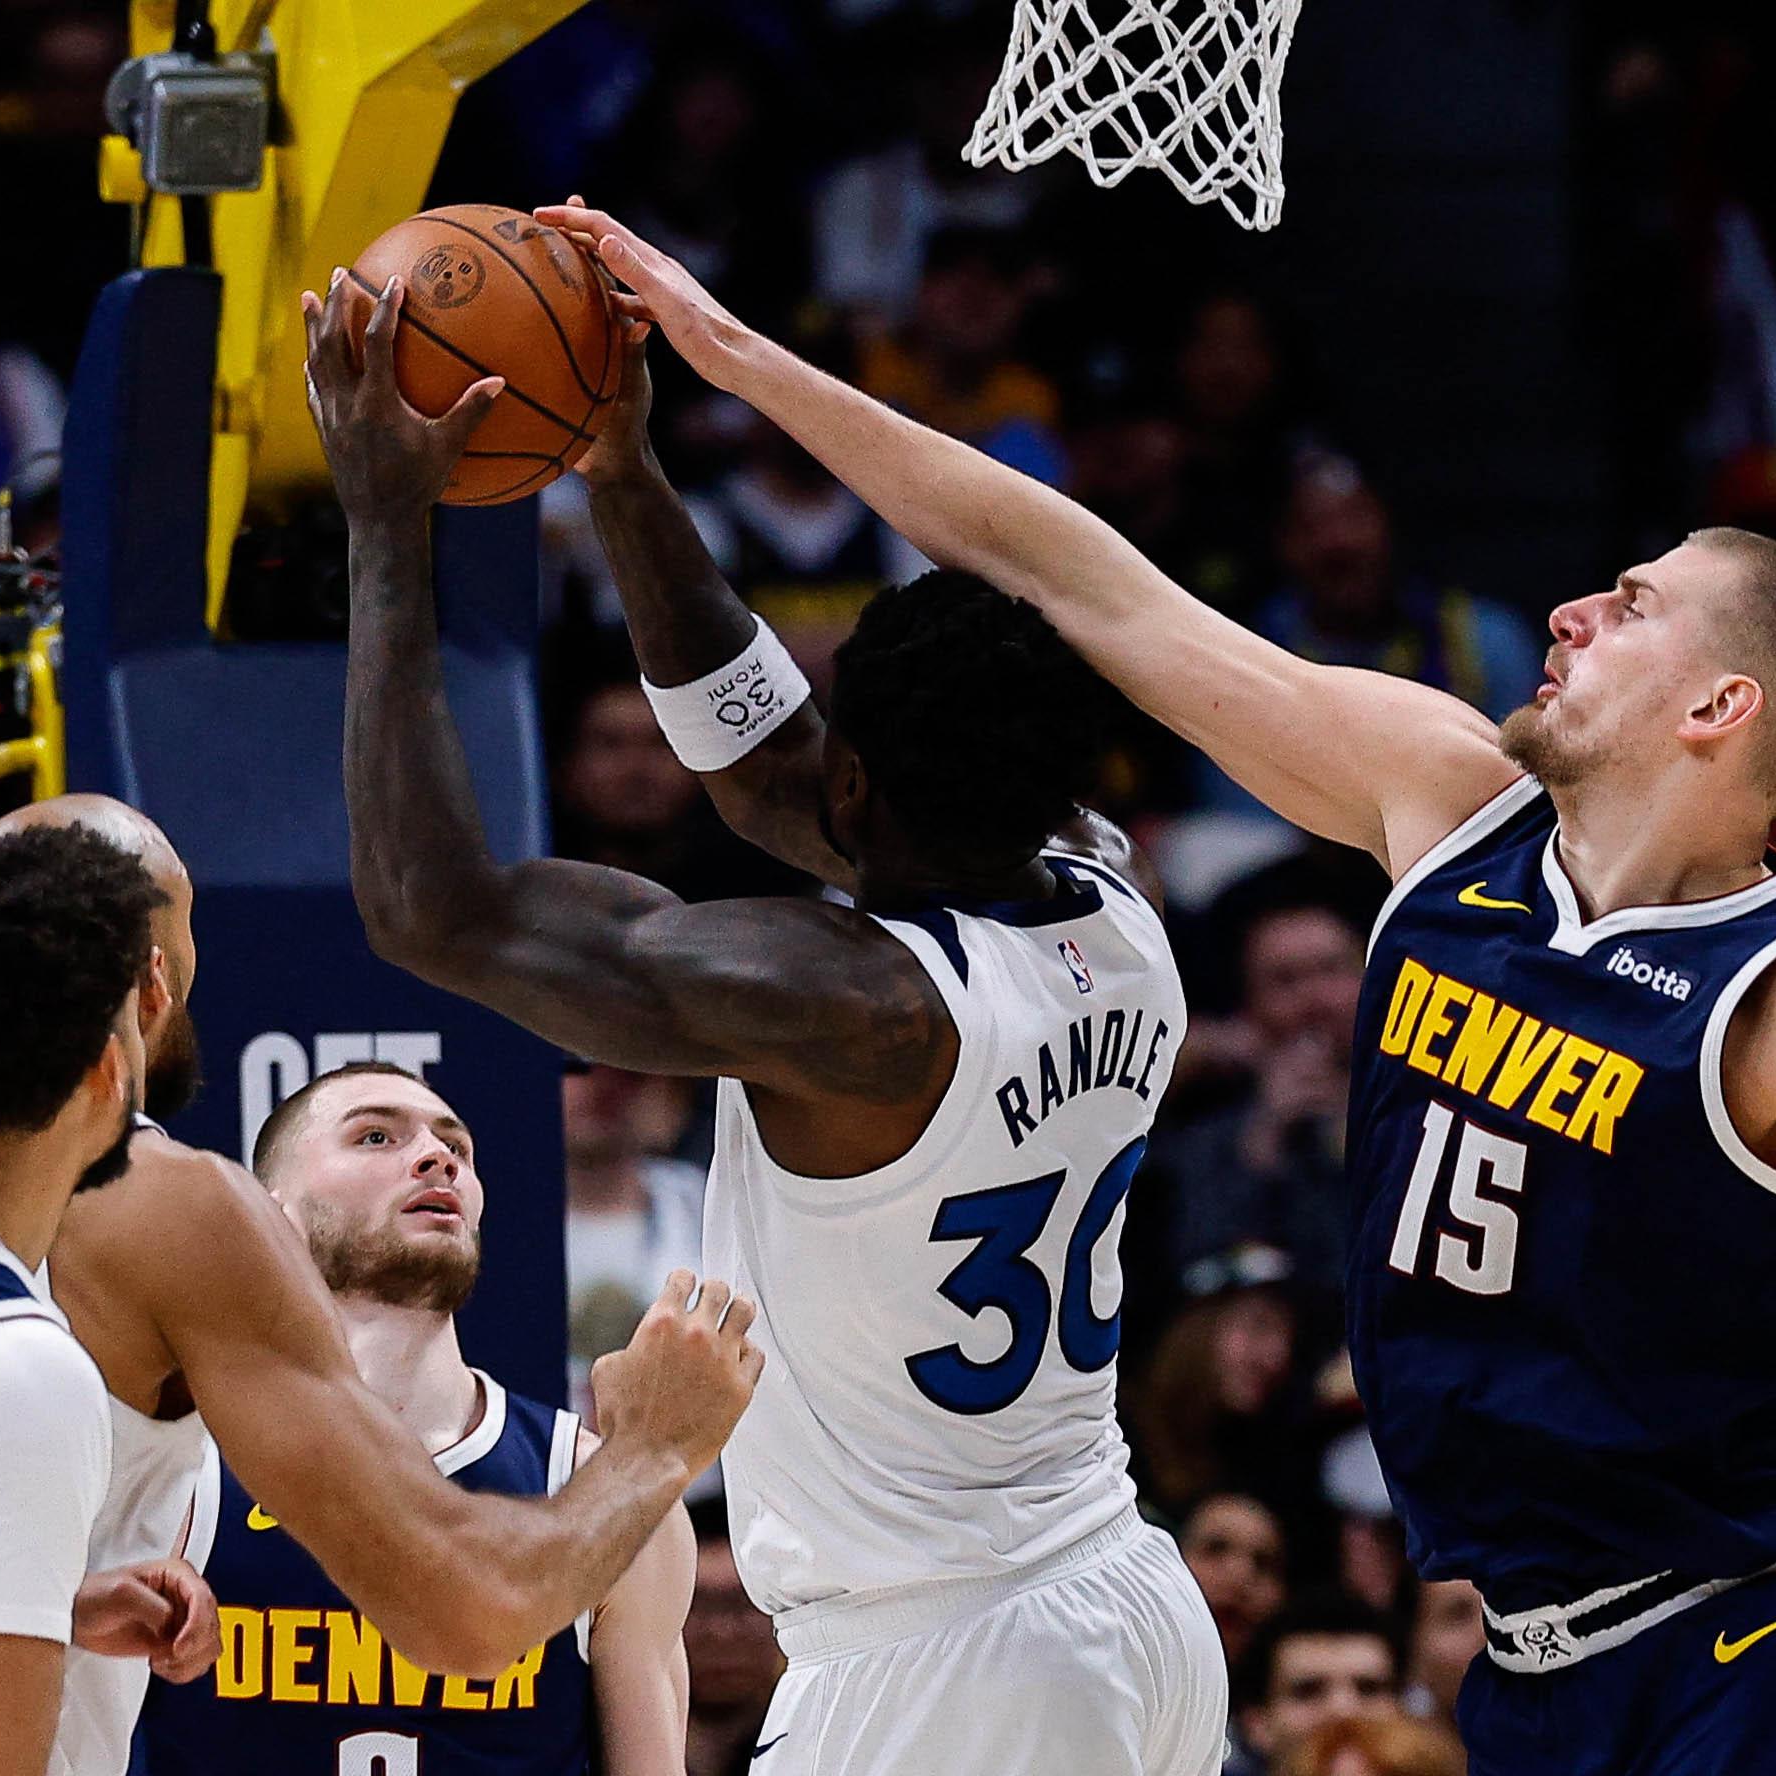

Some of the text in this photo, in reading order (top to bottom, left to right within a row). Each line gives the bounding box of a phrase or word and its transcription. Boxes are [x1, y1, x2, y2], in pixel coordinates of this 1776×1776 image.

[715, 677, 774, 727] 30
[1379, 956, 1645, 1155] DENVER
[1605, 946, 1693, 1002] ibotta
[995, 1008, 1169, 1149] RANDLE
[903, 1133, 1148, 1416] 30
[1388, 1098, 1528, 1296] 15
